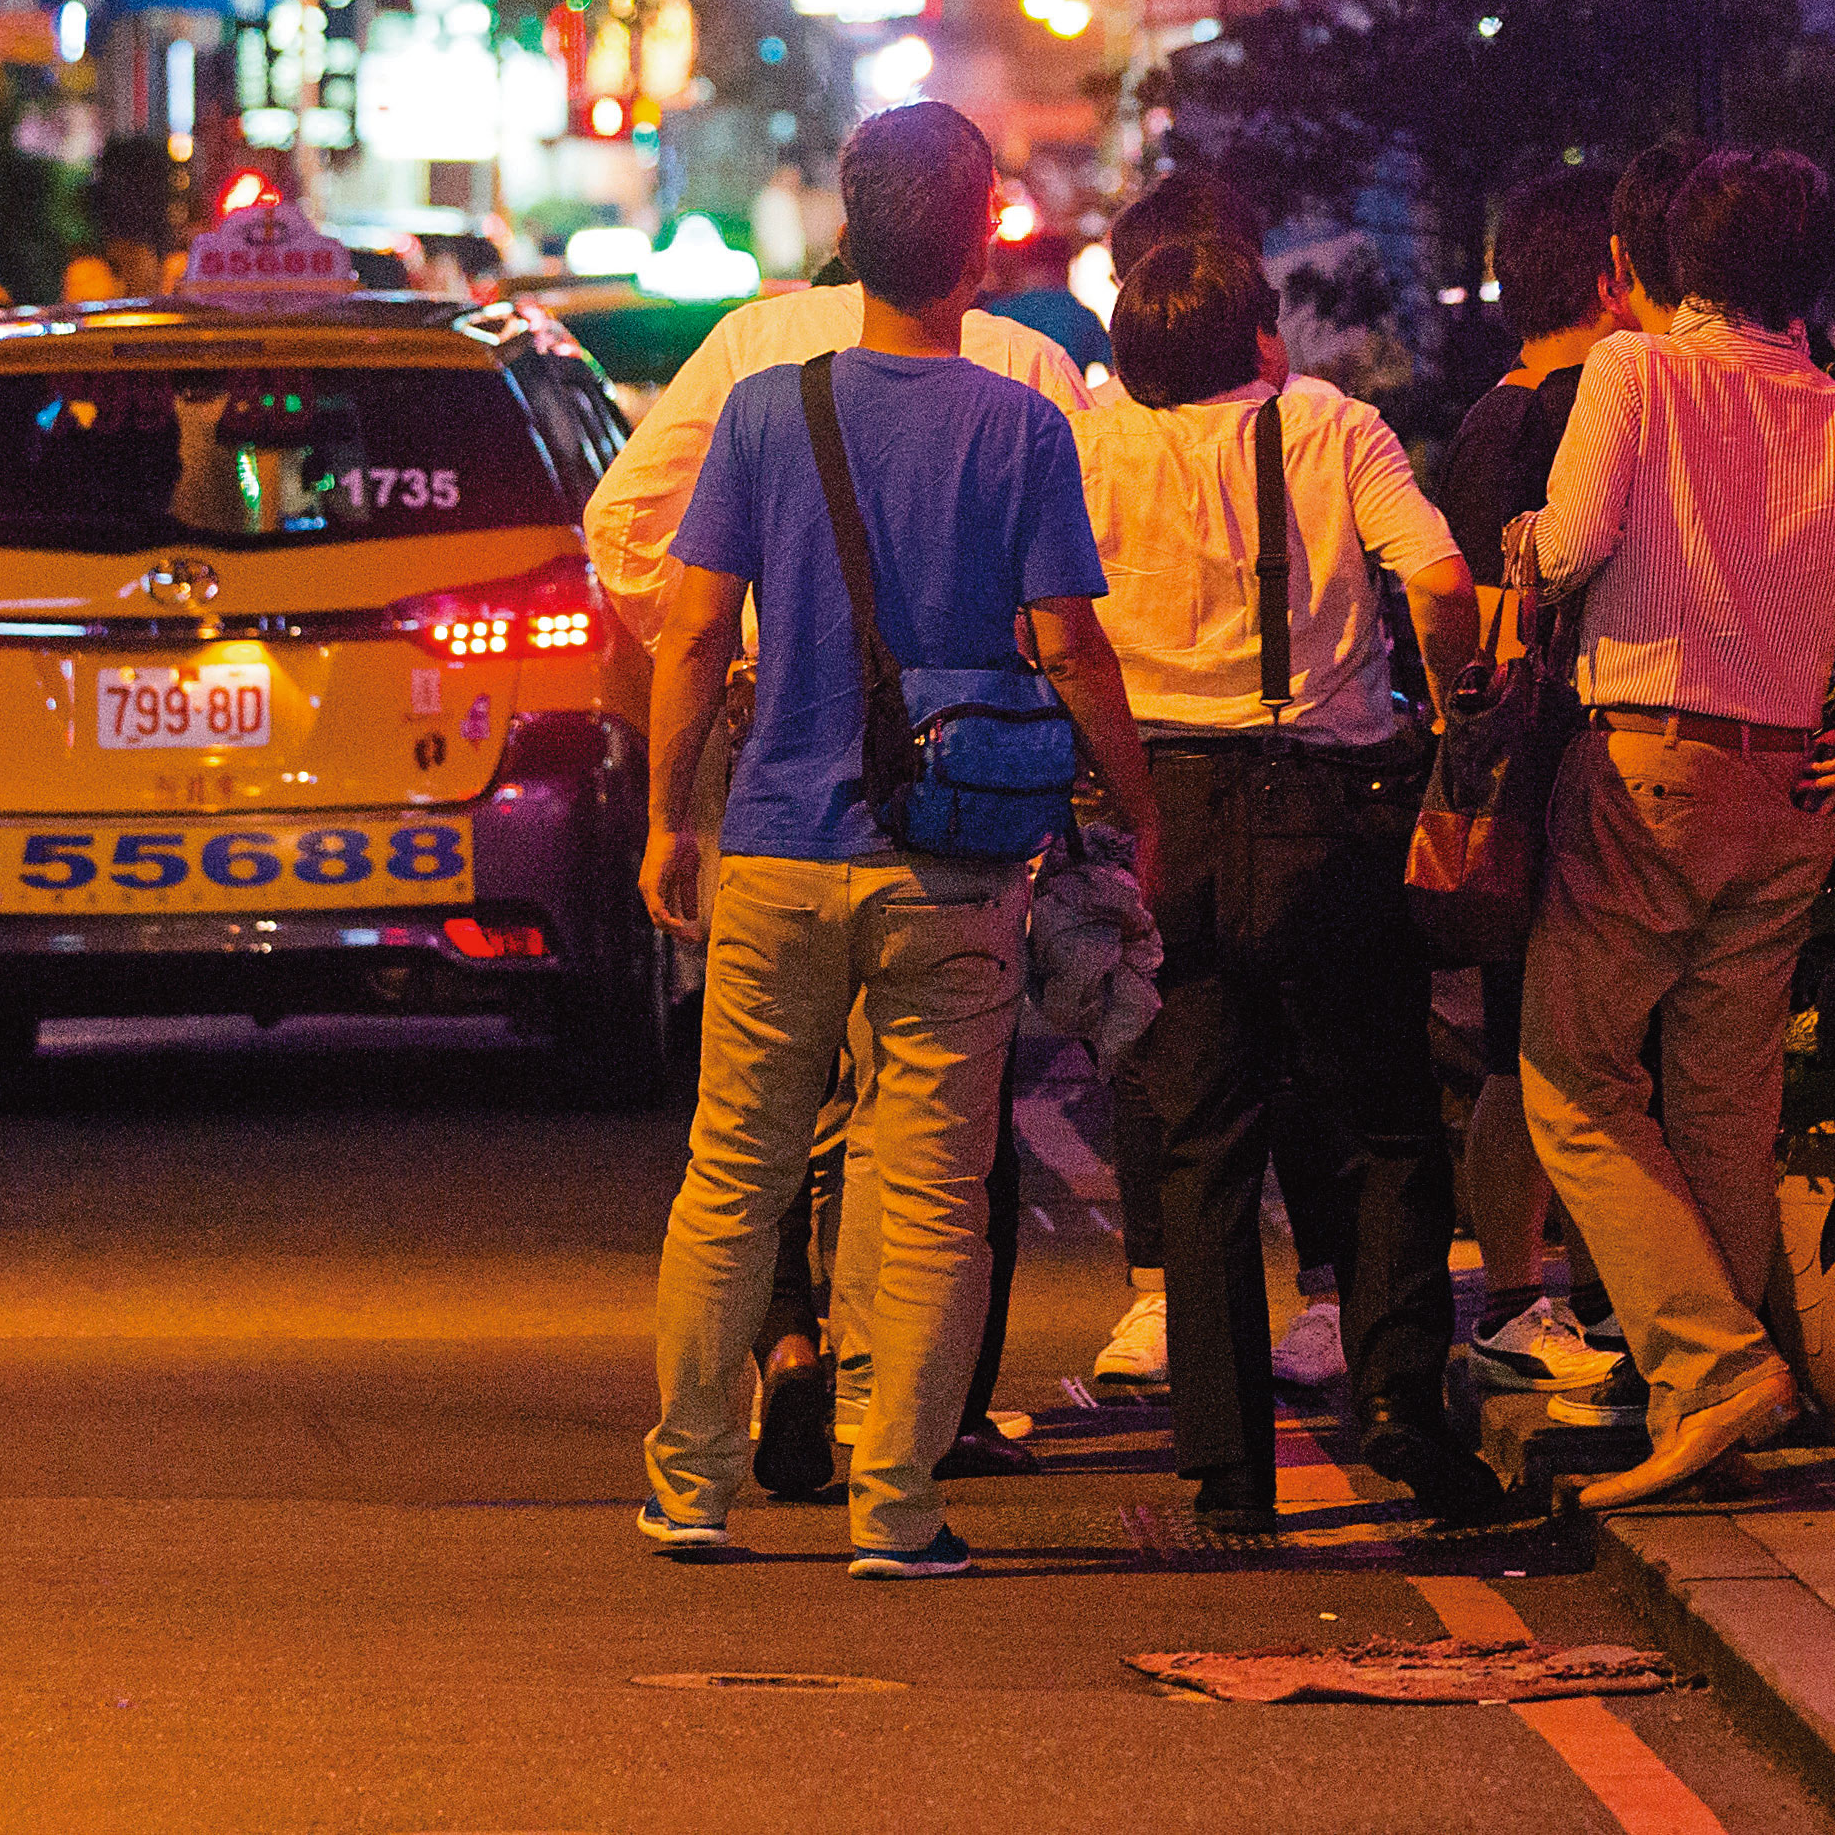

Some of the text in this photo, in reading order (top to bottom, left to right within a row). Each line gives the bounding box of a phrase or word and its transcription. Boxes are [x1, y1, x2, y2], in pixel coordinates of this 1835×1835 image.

[342, 468, 461, 510] 1735
[107, 685, 263, 737] 799-8D
[19, 826, 466, 891] 55688
